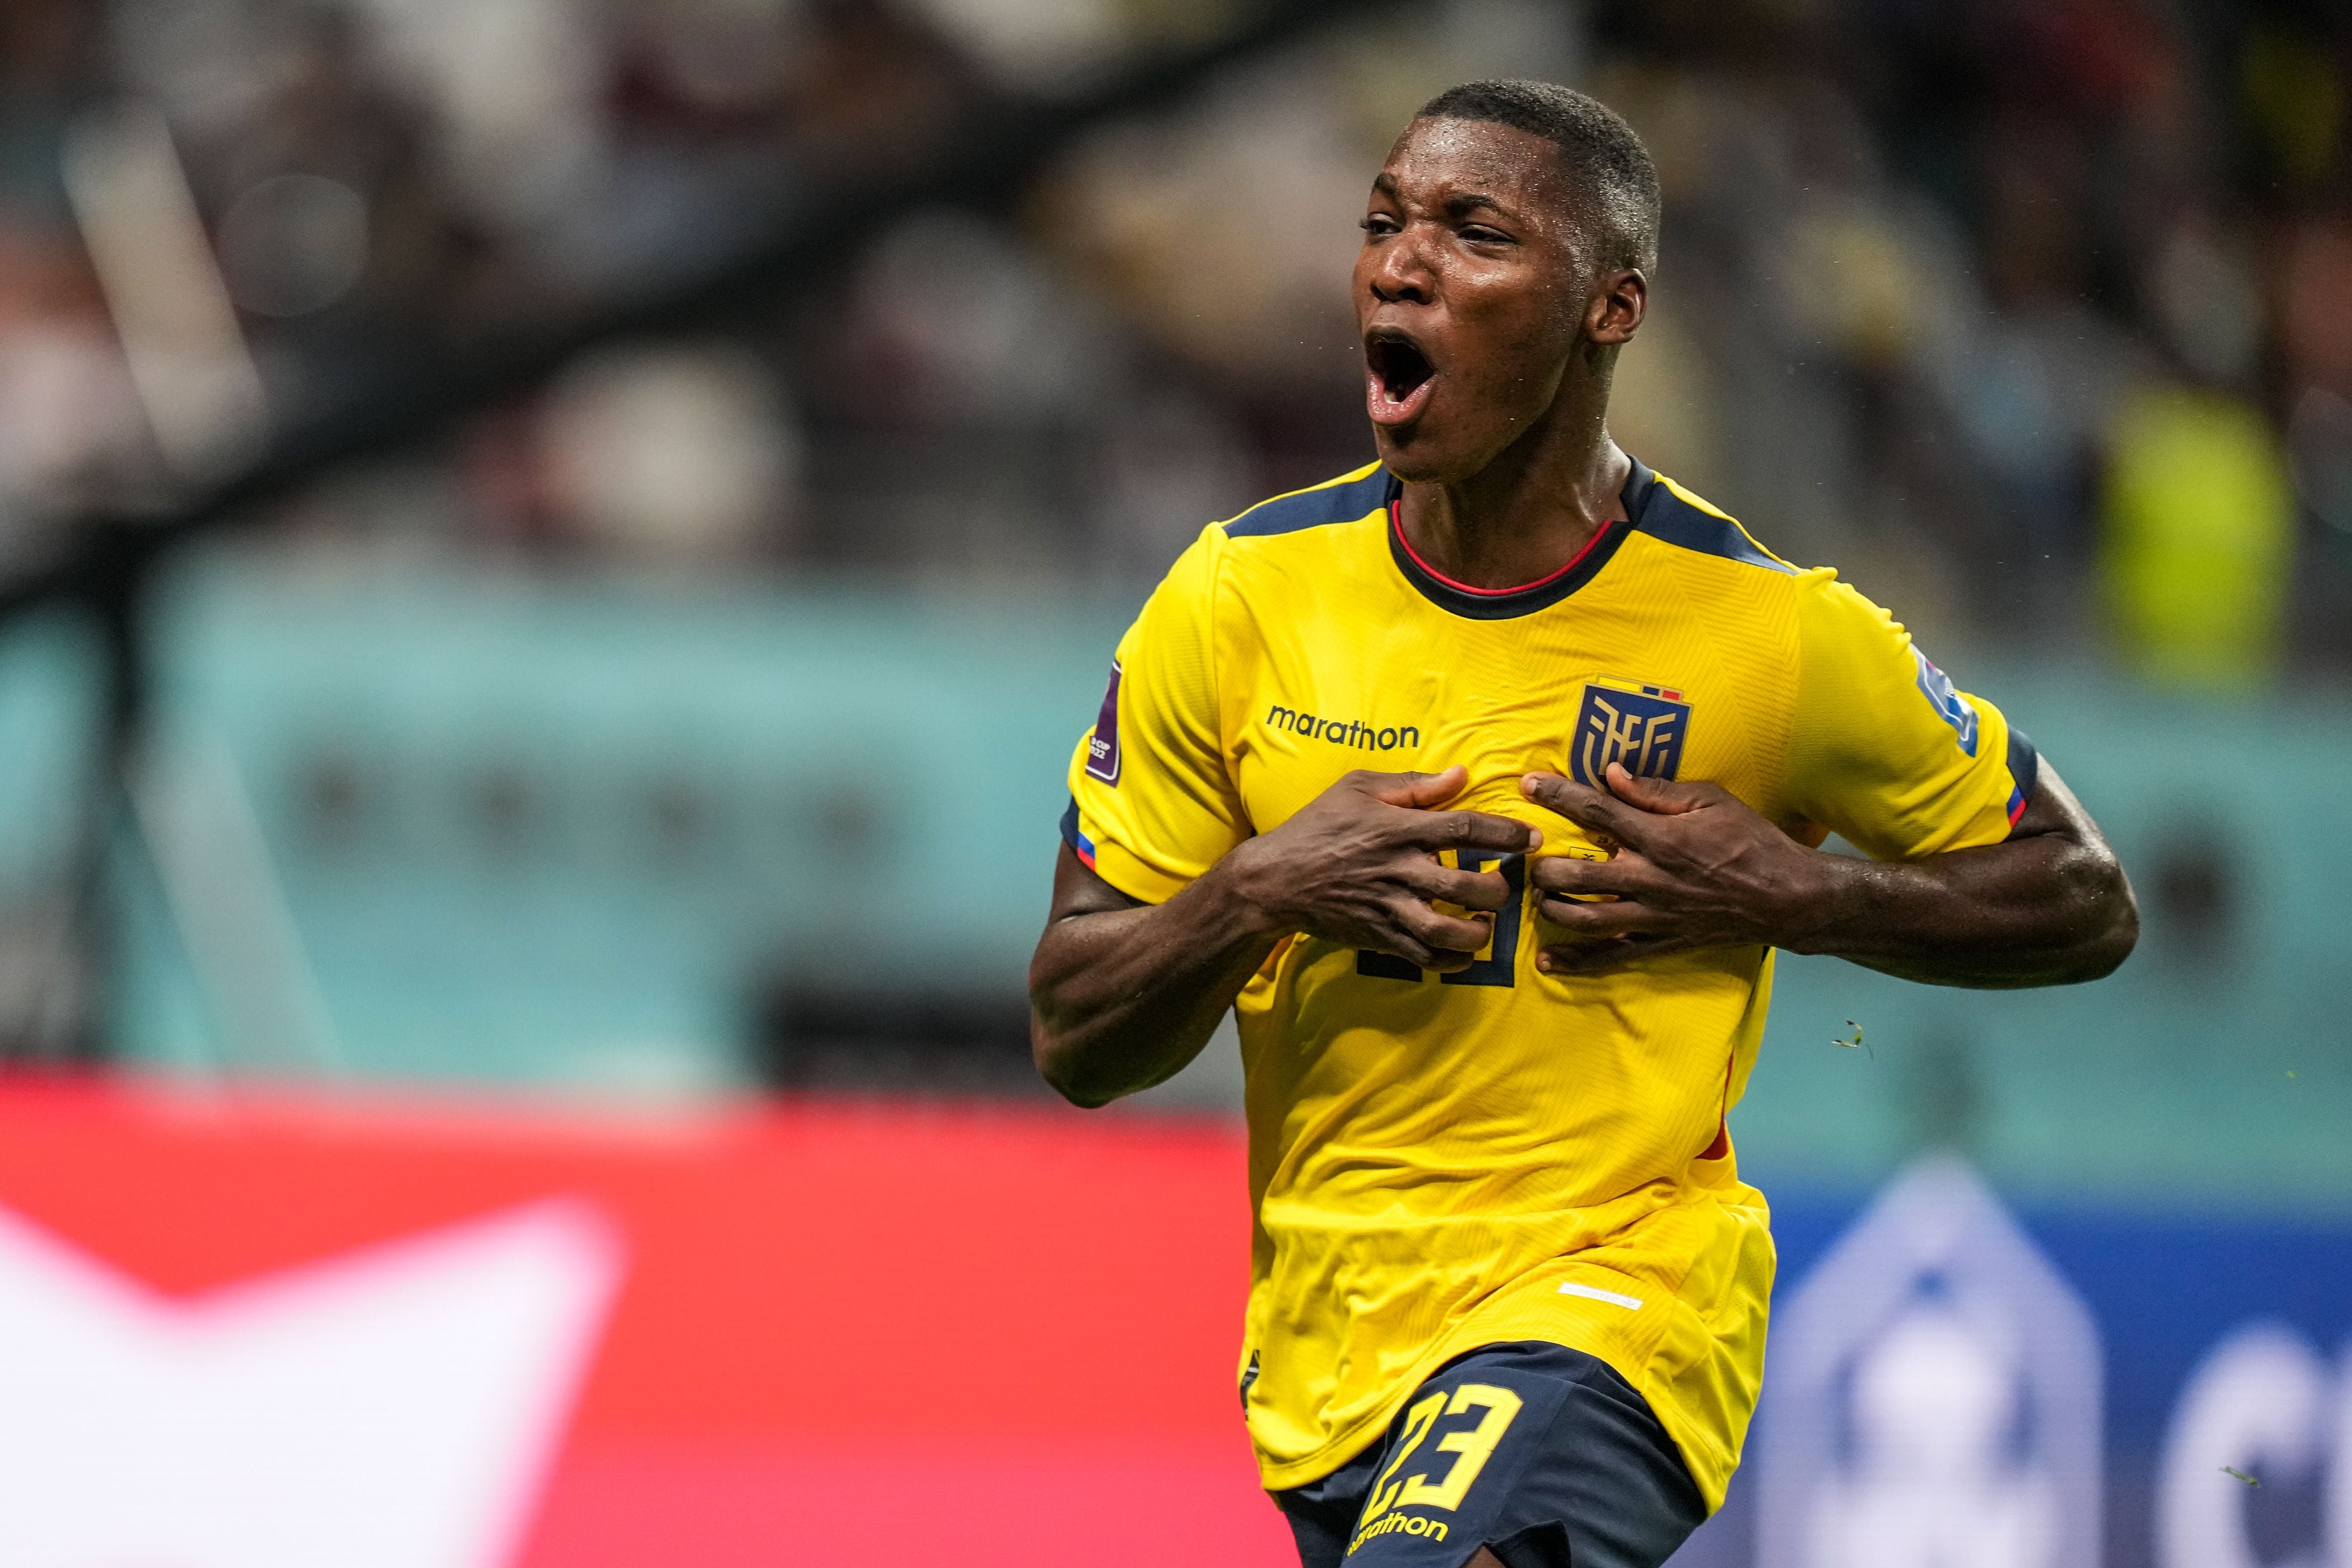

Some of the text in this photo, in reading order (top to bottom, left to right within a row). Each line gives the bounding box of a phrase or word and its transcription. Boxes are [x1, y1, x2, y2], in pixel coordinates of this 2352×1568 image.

[1266, 705, 1419, 751] marathon
[1357, 848, 1526, 988] 3
[1359, 1382, 1524, 1530] 23
